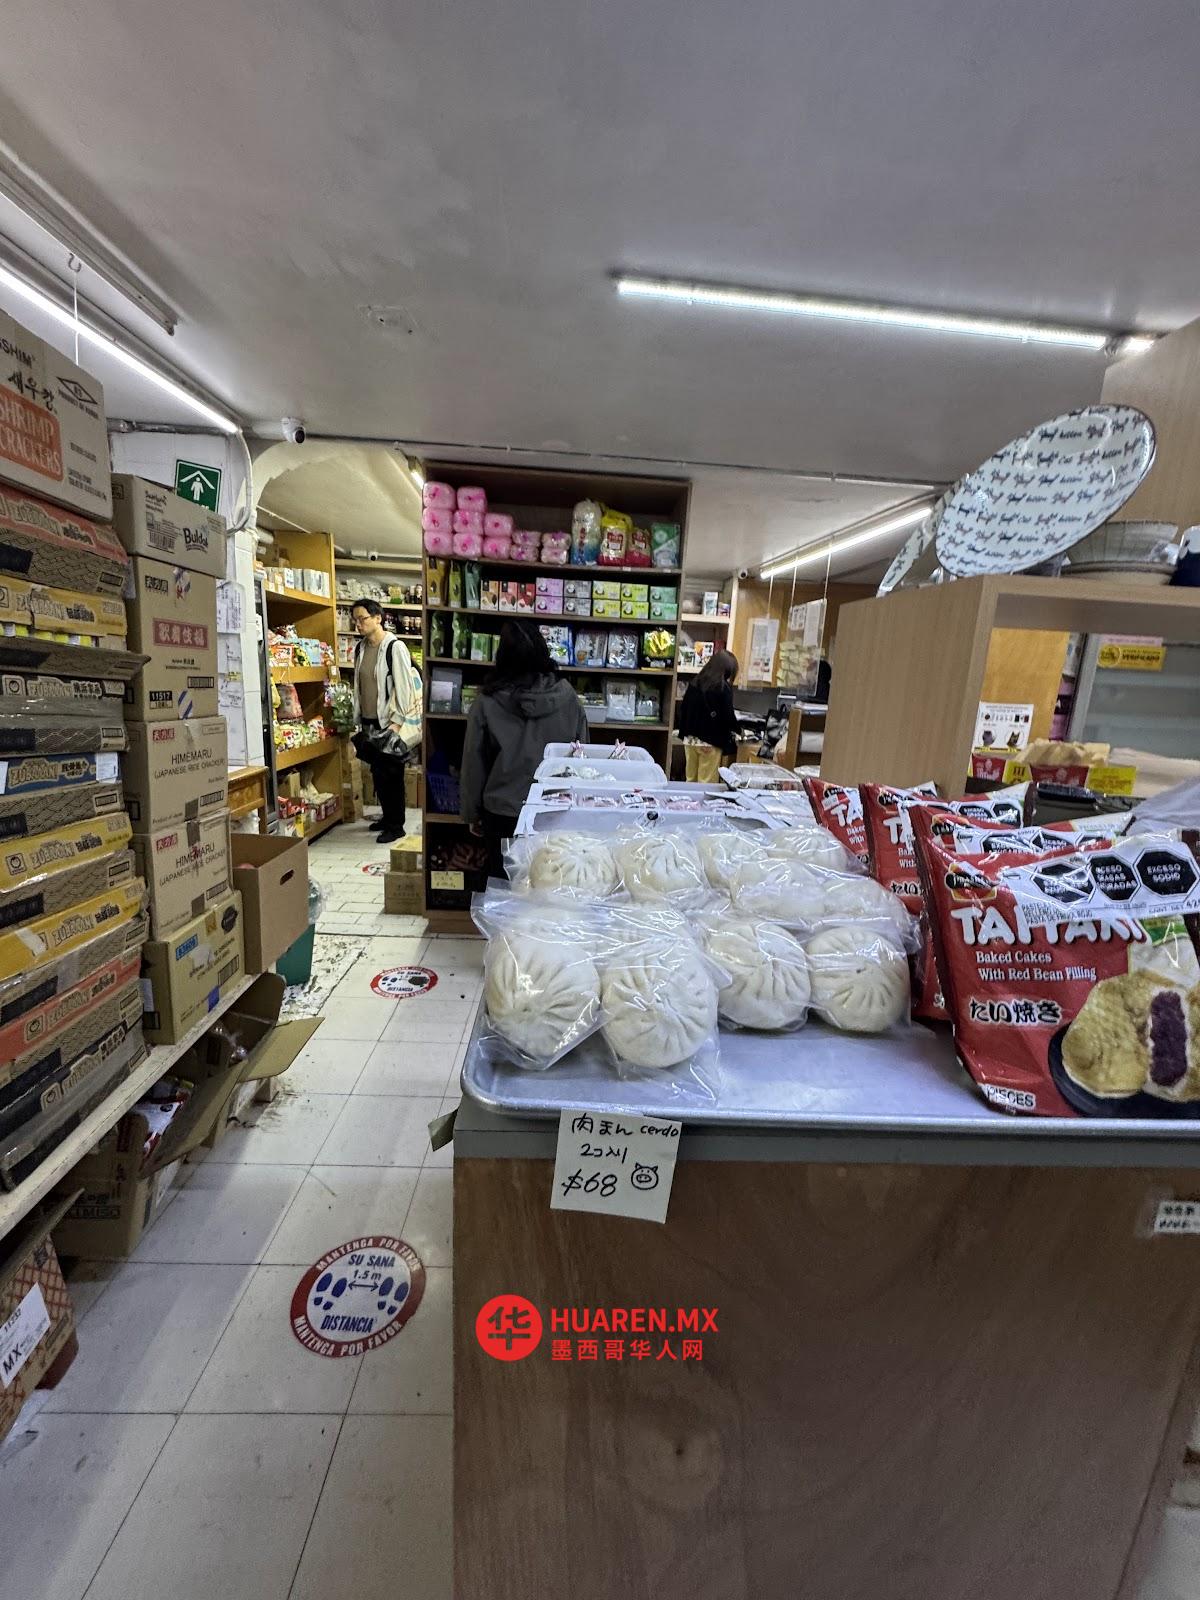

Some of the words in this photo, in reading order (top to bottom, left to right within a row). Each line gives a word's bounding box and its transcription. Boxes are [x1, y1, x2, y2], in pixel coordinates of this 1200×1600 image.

[0, 338, 33, 370] SHIM
[171, 748, 212, 765] HIMEMARU
[1147, 863, 1181, 874] EXCESO
[1152, 872, 1181, 883] SODIO
[976, 950, 1012, 964] Baked
[1014, 951, 1052, 964] Cakes
[978, 967, 1005, 981] With
[1007, 967, 1030, 981] Red
[1034, 967, 1063, 981] Bean
[1065, 966, 1096, 981] Filling
[969, 998, 1061, 1025] たい焼き
[572, 1112, 633, 1136] 肉まん
[640, 1124, 679, 1137] cerdo
[561, 1168, 618, 1197] $68
[316, 1238, 374, 1271] MANTENGA
[379, 1237, 400, 1250] POR
[348, 1253, 365, 1267] SU
[367, 1254, 396, 1268] SANA
[353, 1269, 369, 1280] 1.5
[371, 1272, 382, 1280] m
[320, 1314, 374, 1334] DISTANCIA
[294, 1314, 336, 1357] MANTENGA
[340, 1343, 364, 1357] POR
[367, 1320, 403, 1350] FAVOR
